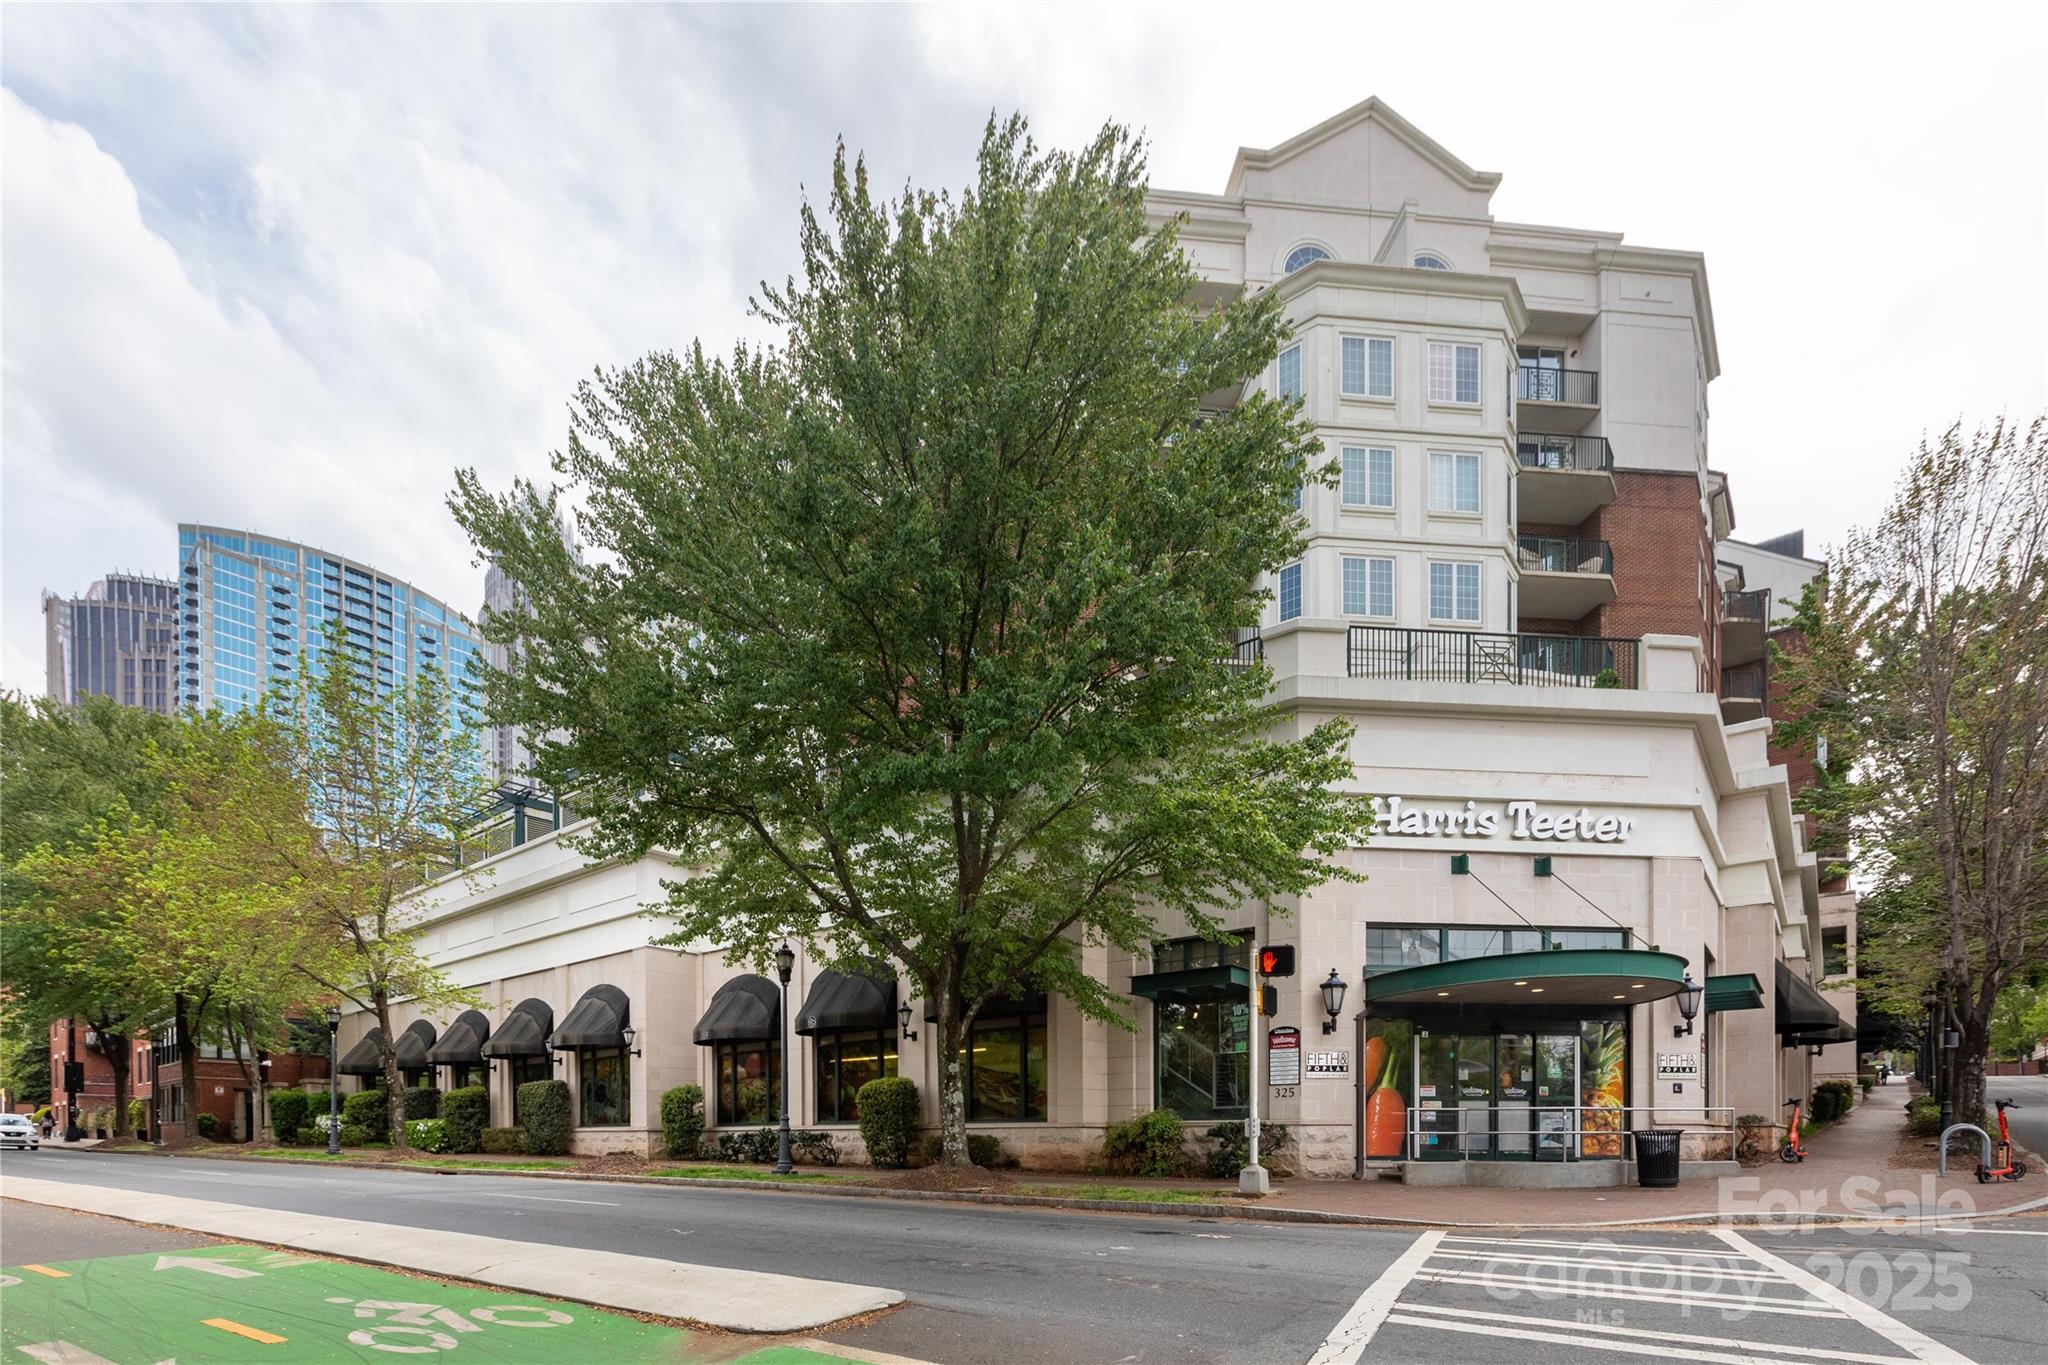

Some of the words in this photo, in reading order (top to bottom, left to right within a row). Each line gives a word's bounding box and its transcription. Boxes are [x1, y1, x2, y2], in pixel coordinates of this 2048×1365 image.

[1370, 796, 1499, 836] Harris
[1507, 801, 1635, 842] Teeter
[1274, 1087, 1295, 1098] 325
